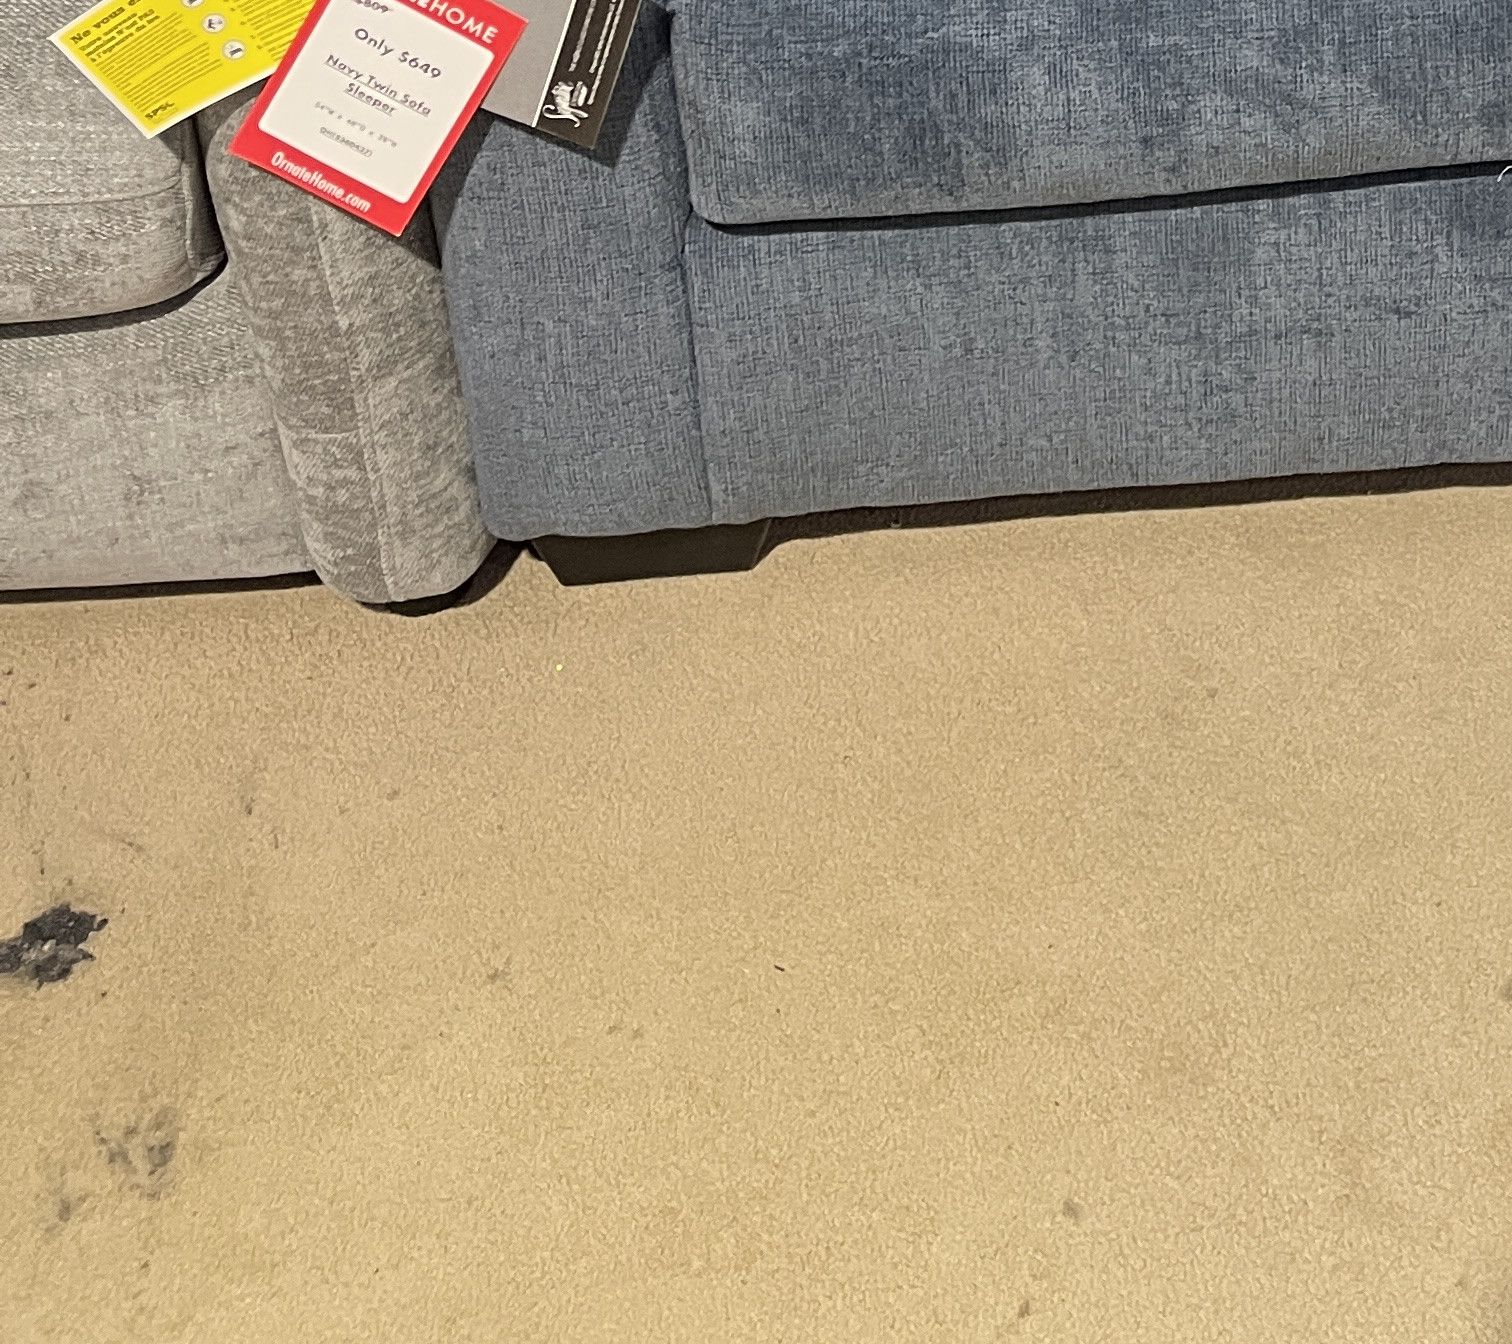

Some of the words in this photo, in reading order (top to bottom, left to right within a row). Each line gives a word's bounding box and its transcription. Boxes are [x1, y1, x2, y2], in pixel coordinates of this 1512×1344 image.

[93, 7, 126, 29] vous
[354, 28, 394, 56] Only
[399, 51, 442, 79] $649
[326, 54, 363, 80] Navy
[367, 74, 398, 99] Twin
[401, 94, 432, 116] Sofa
[345, 82, 398, 116] Sleeper
[271, 151, 371, 213] OrnateHome.com
